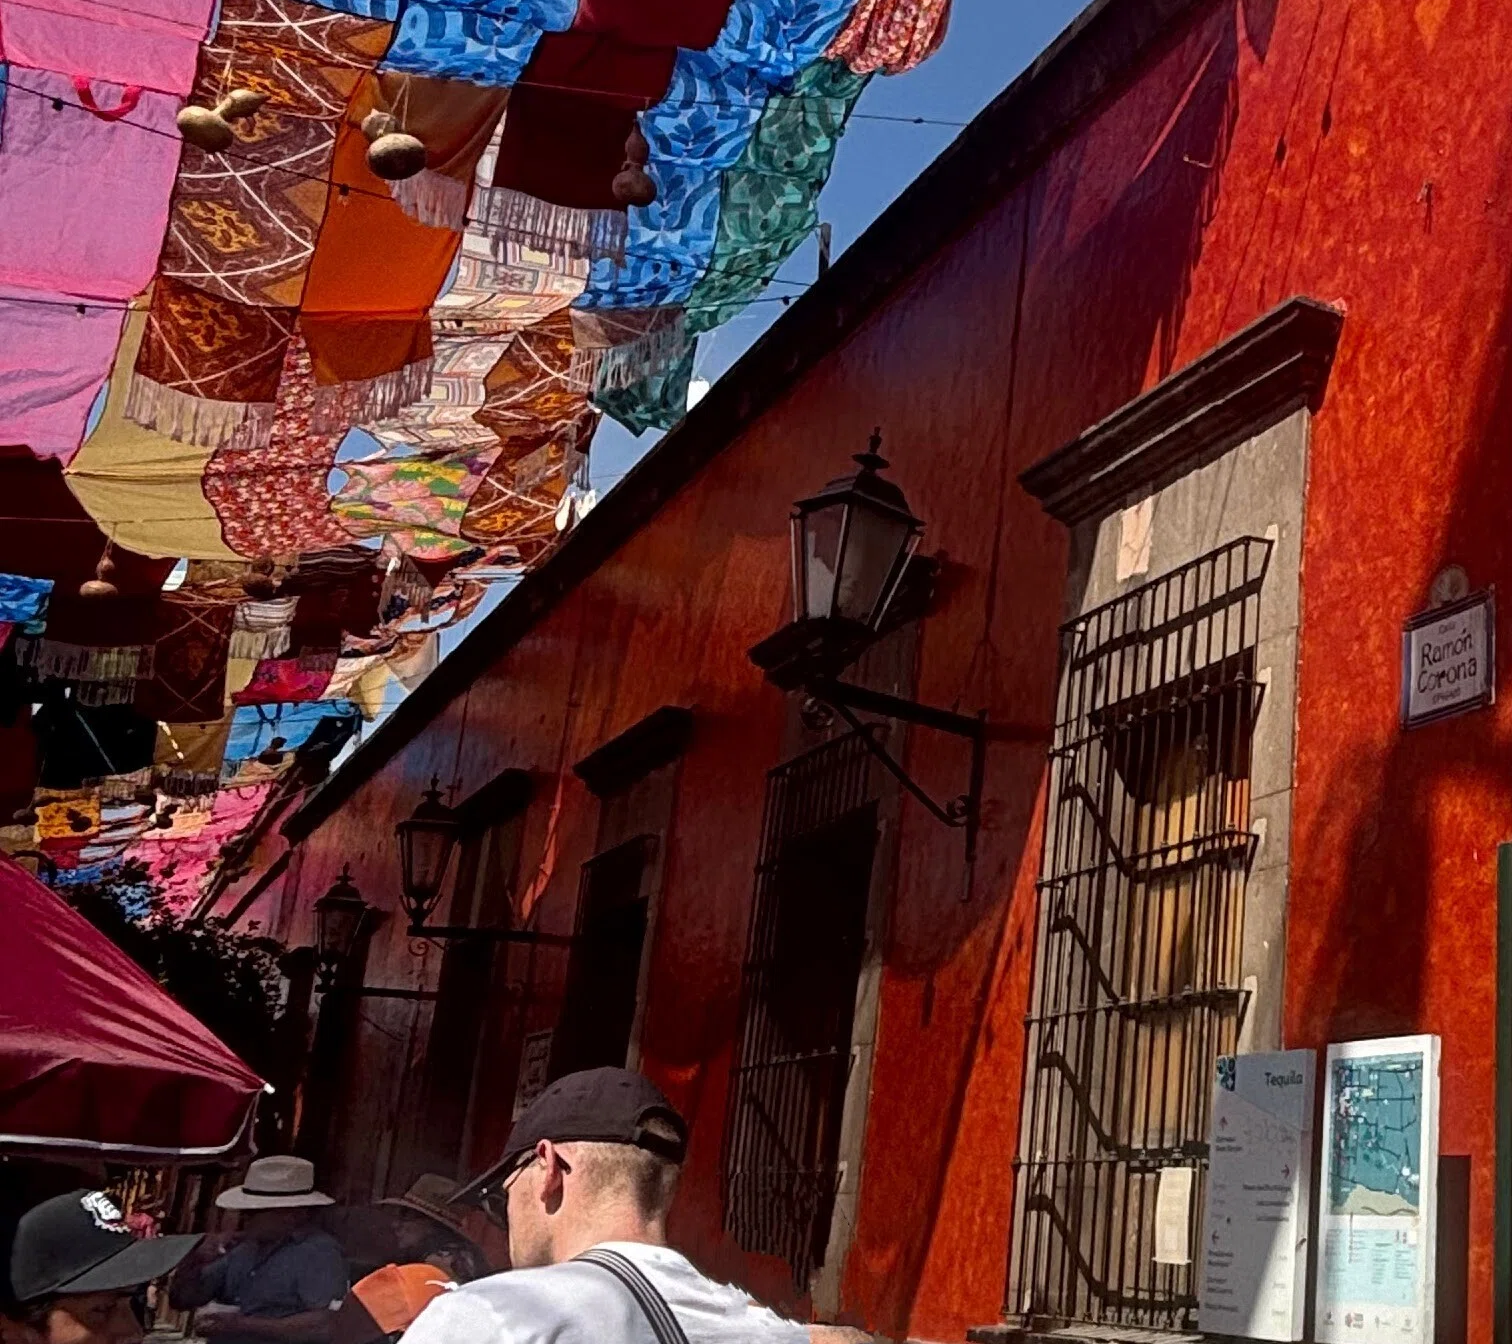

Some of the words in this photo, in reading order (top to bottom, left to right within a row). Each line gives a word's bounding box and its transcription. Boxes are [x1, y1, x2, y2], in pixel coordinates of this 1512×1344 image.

[1421, 628, 1473, 667] Ramón
[1417, 657, 1478, 693] Corona
[1264, 1070, 1304, 1088] Tequila
